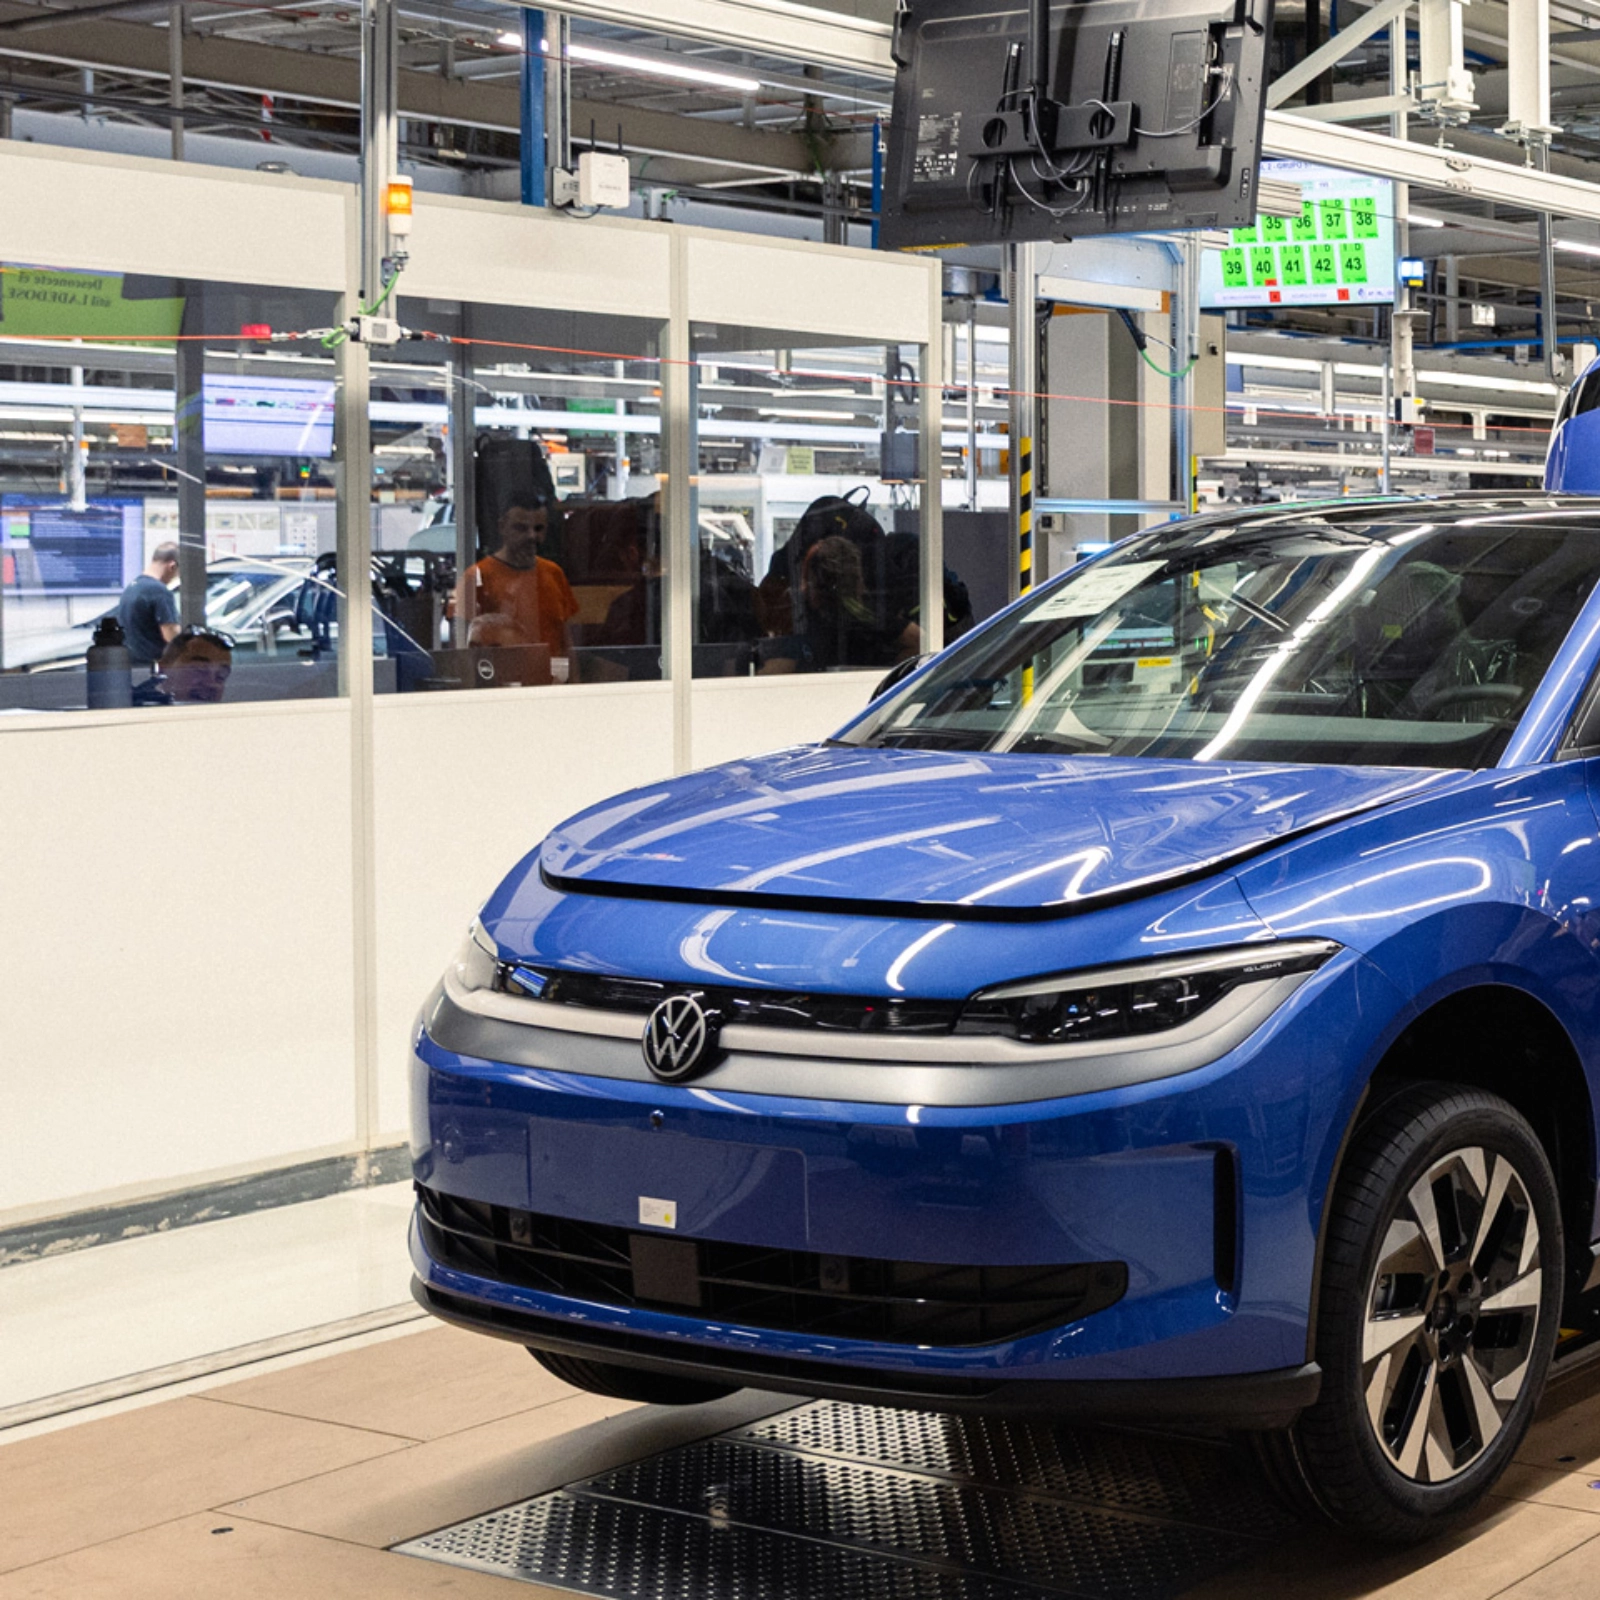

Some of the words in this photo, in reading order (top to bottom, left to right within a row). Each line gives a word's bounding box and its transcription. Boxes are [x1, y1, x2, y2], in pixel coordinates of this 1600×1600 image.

[1266, 216, 1282, 229] 35
[1296, 215, 1311, 229] 36
[1325, 213, 1341, 227] 37
[1356, 211, 1372, 226] 38
[1226, 261, 1242, 275] 39
[1256, 260, 1271, 274] 40
[1285, 259, 1300, 273] 41
[1315, 258, 1332, 272] 42
[1345, 256, 1362, 271] 43
